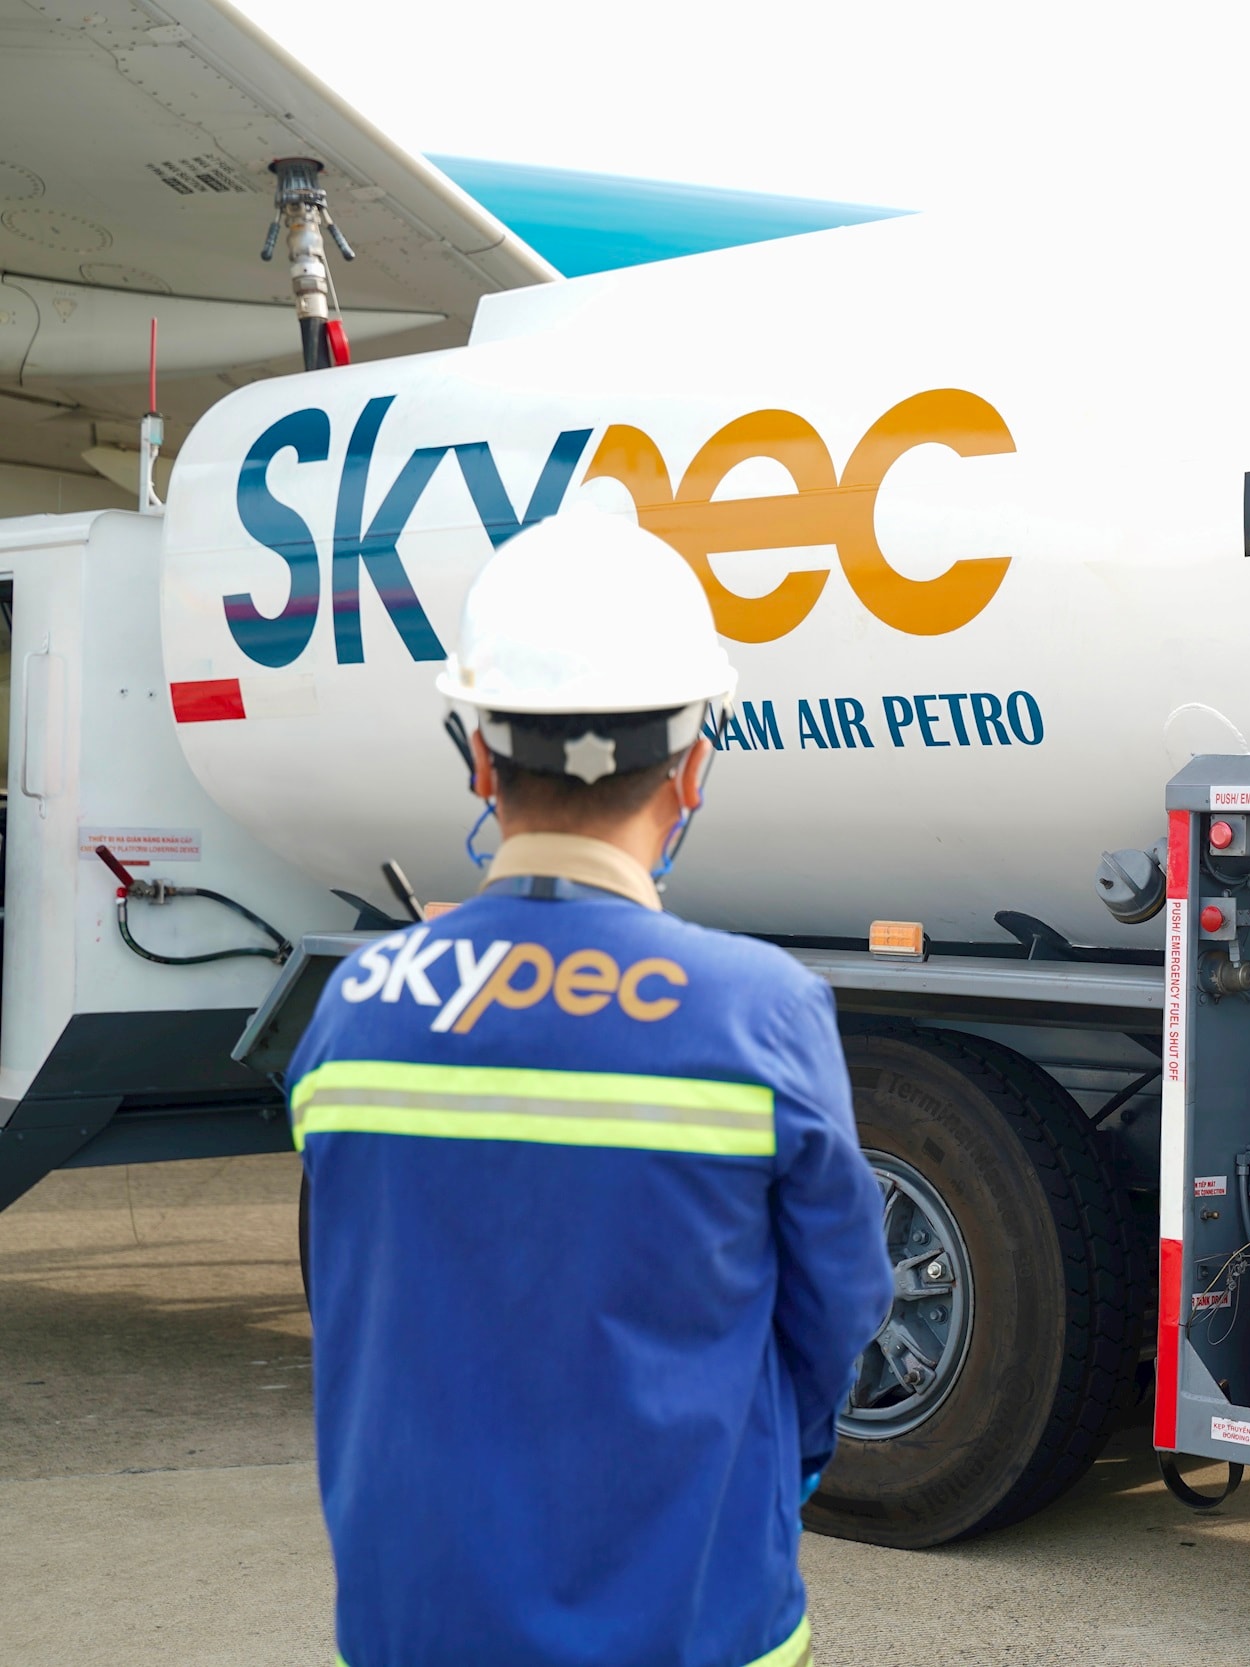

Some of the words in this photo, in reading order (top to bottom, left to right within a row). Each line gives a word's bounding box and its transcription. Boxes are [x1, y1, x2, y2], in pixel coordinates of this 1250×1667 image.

[798, 697, 875, 750] AIR
[882, 690, 1044, 748] PETRO
[1215, 793, 1239, 804] PUSH/
[1170, 901, 1181, 933] PUSH/
[341, 927, 689, 1034] Skypec
[1169, 935, 1181, 1000] EMERGENCY
[1169, 1002, 1180, 1029] FUEL
[1169, 1031, 1179, 1058] SHUT
[1168, 1060, 1179, 1081] OFF
[1222, 1432, 1250, 1442] BONDING
